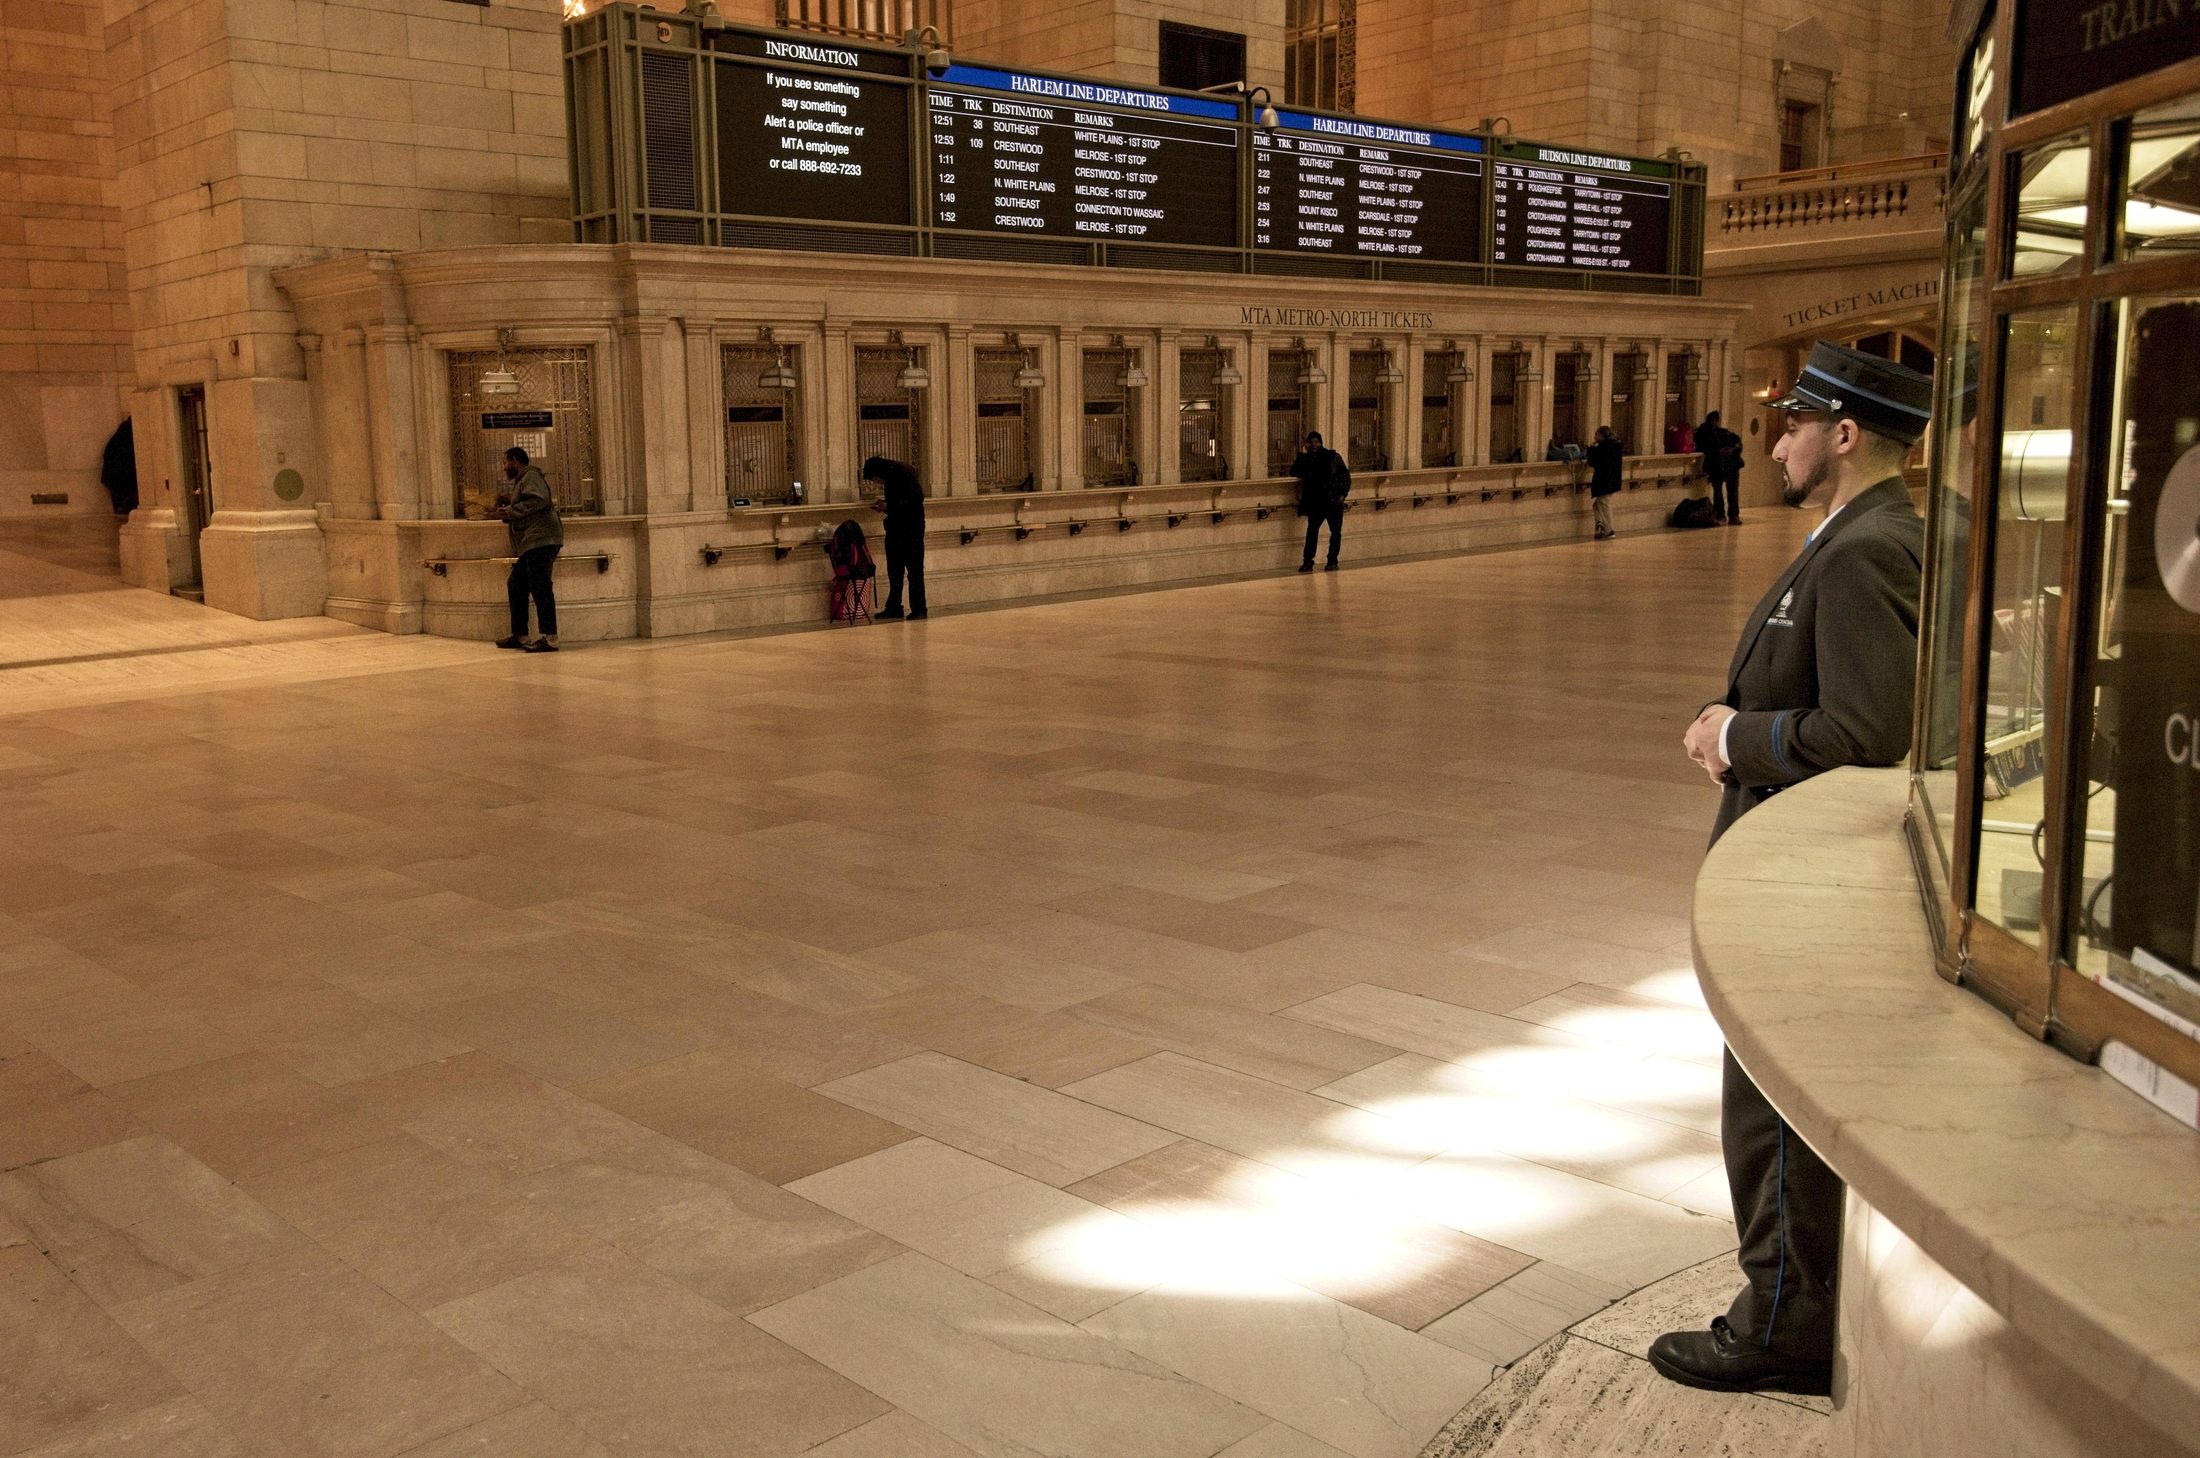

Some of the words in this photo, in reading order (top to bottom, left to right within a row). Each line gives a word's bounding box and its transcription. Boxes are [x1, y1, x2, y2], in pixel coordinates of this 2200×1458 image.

[765, 41, 858, 66] INFORMATION
[767, 73, 773, 85] If
[775, 75, 792, 88] you
[794, 78, 811, 89] see
[814, 81, 859, 98] something
[1011, 76, 1064, 97] HARLEM
[1065, 85, 1093, 100] LINE
[1096, 88, 1169, 110] DEPARTURES
[782, 97, 798, 110] say
[800, 99, 846, 116] something
[929, 95, 953, 108] TIME
[963, 99, 983, 111] TRK
[992, 103, 1053, 119] DESTINATION
[1074, 113, 1113, 126] REMARKS
[764, 115, 786, 128] Alert
[788, 120, 795, 129] a
[797, 119, 823, 136] police
[825, 123, 853, 134] officer
[855, 126, 864, 136] or
[933, 114, 953, 126] 12:51
[973, 119, 983, 129] 38
[994, 122, 1039, 135] SOUTHEAST
[1075, 131, 1099, 143] WHITE
[1099, 134, 1123, 146] PLAINS
[1128, 137, 1141, 147] 1ST
[1142, 138, 1160, 149] STOP
[1313, 118, 1352, 134] HARLEM
[1353, 124, 1375, 137] LINE
[1376, 127, 1430, 145] DEPARTURES
[782, 137, 804, 150] MTA
[806, 141, 849, 156] employee
[934, 134, 954, 145] 12:53
[970, 138, 983, 148] 109
[994, 141, 1043, 154] CRESTWOOD
[1075, 149, 1109, 162] MELROSE
[1114, 153, 1127, 163] 1ST
[1128, 154, 1146, 165] STOP
[1253, 135, 1270, 146] TIME
[1277, 138, 1292, 149] TRK
[1299, 141, 1344, 155] DESTINATION
[1360, 149, 1389, 160] REMARKS
[770, 158, 780, 168] or
[782, 159, 798, 170] call
[799, 160, 861, 175] 888-692-7233
[939, 154, 953, 164] 1:11
[994, 160, 1040, 172] SOUTHEAST
[1075, 167, 1121, 180] CRESTWOOD
[1126, 172, 1138, 181] 1ST
[1139, 172, 1158, 183] STOP
[1258, 153, 1269, 162] 2:11
[1299, 157, 1333, 169] SOUTHEAST
[1359, 164, 1394, 176] CRESTWOOD
[1397, 170, 1407, 178] 1ST
[1407, 170, 1421, 179] STOP
[1539, 149, 1570, 164] HUDSON
[1571, 153, 1587, 166] LINE
[1589, 156, 1631, 171] DEPARTURES
[939, 174, 954, 184] 1:22
[994, 178, 1003, 188] N.
[1004, 179, 1029, 190] WHITE
[1030, 181, 1055, 193] PLAINS
[1075, 185, 1109, 197] MELROSE
[1115, 189, 1127, 198] 1ST
[1128, 190, 1146, 200] STOP
[1258, 169, 1270, 178] 2:22
[1299, 173, 1305, 182] N.
[1305, 174, 1324, 184] WHITE
[1325, 176, 1344, 186] PLAINS
[1359, 180, 1385, 190] MELROSE
[1389, 184, 1398, 192] 1ST
[1399, 184, 1413, 193] STOP
[939, 193, 955, 203] 1:49
[995, 197, 1040, 209] SOUTHEAST
[1075, 203, 1121, 215] CONNECTION
[1122, 206, 1132, 216] TO
[1133, 207, 1164, 219] WASSAIC
[1258, 186, 1270, 194] 2:47
[1299, 190, 1333, 200] SOUTHEAST
[1359, 195, 1376, 205] WHITE
[1377, 197, 1395, 207] PLAINS
[1399, 199, 1408, 208] 1ST
[1408, 200, 1423, 209] STOP
[940, 212, 956, 222] 1:52
[995, 215, 1044, 228] CRESTWOOD
[1076, 221, 1109, 232] MELROSE
[1115, 224, 1127, 233] 1ST
[1128, 225, 1147, 235] STOP
[1258, 202, 1269, 211] 2:53
[1299, 206, 1320, 215] MOUNT
[1320, 208, 1337, 217] KISCO
[1359, 211, 1390, 221] SCARSDALE
[1394, 214, 1403, 222] 1ST
[1404, 215, 1418, 224] STOP
[1258, 218, 1269, 227] 2:54
[1299, 221, 1305, 230] N.
[1305, 222, 1324, 231] WHITE
[1324, 224, 1344, 233] PLAINS
[1359, 226, 1384, 236] MELROSE
[1388, 229, 1397, 237] 1ST
[1398, 230, 1412, 238] STOP
[1257, 235, 1269, 243] 3:16
[1299, 237, 1332, 247] SOUTHEAST
[1358, 242, 1376, 251] WHITE
[1376, 243, 1394, 252] PLAINS
[1398, 245, 1407, 253] 1ST
[1408, 246, 1422, 254] STOP
[1241, 307, 1271, 324] MTA
[1276, 308, 1378, 327] METRO-NORTH
[1382, 312, 1432, 328] TICKETS
[1783, 296, 1860, 327] TICKET
